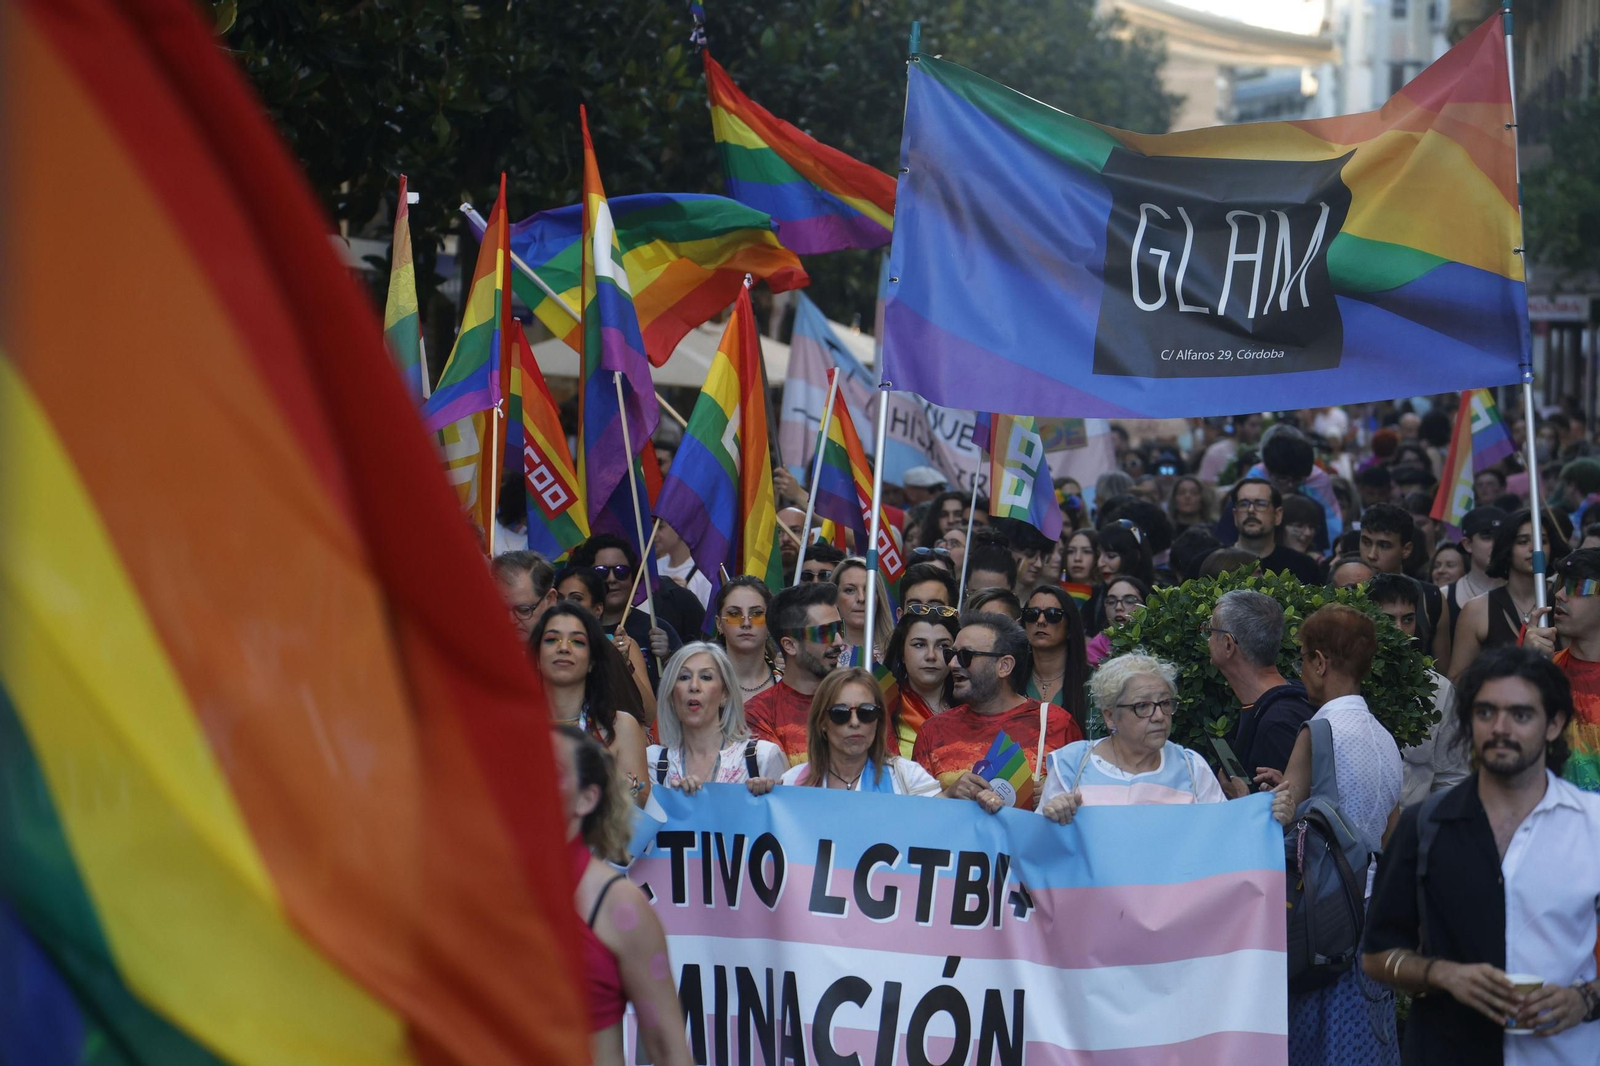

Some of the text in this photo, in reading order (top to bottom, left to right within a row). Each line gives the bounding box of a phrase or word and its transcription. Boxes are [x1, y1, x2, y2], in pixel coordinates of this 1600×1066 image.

[1131, 202, 1330, 319] GLAM
[1160, 348, 1285, 362] C/ Alfaros 29, Córdoba
[642, 831, 1037, 931] TIVO LGTBI+
[636, 955, 1026, 1066] MINACIÓN
